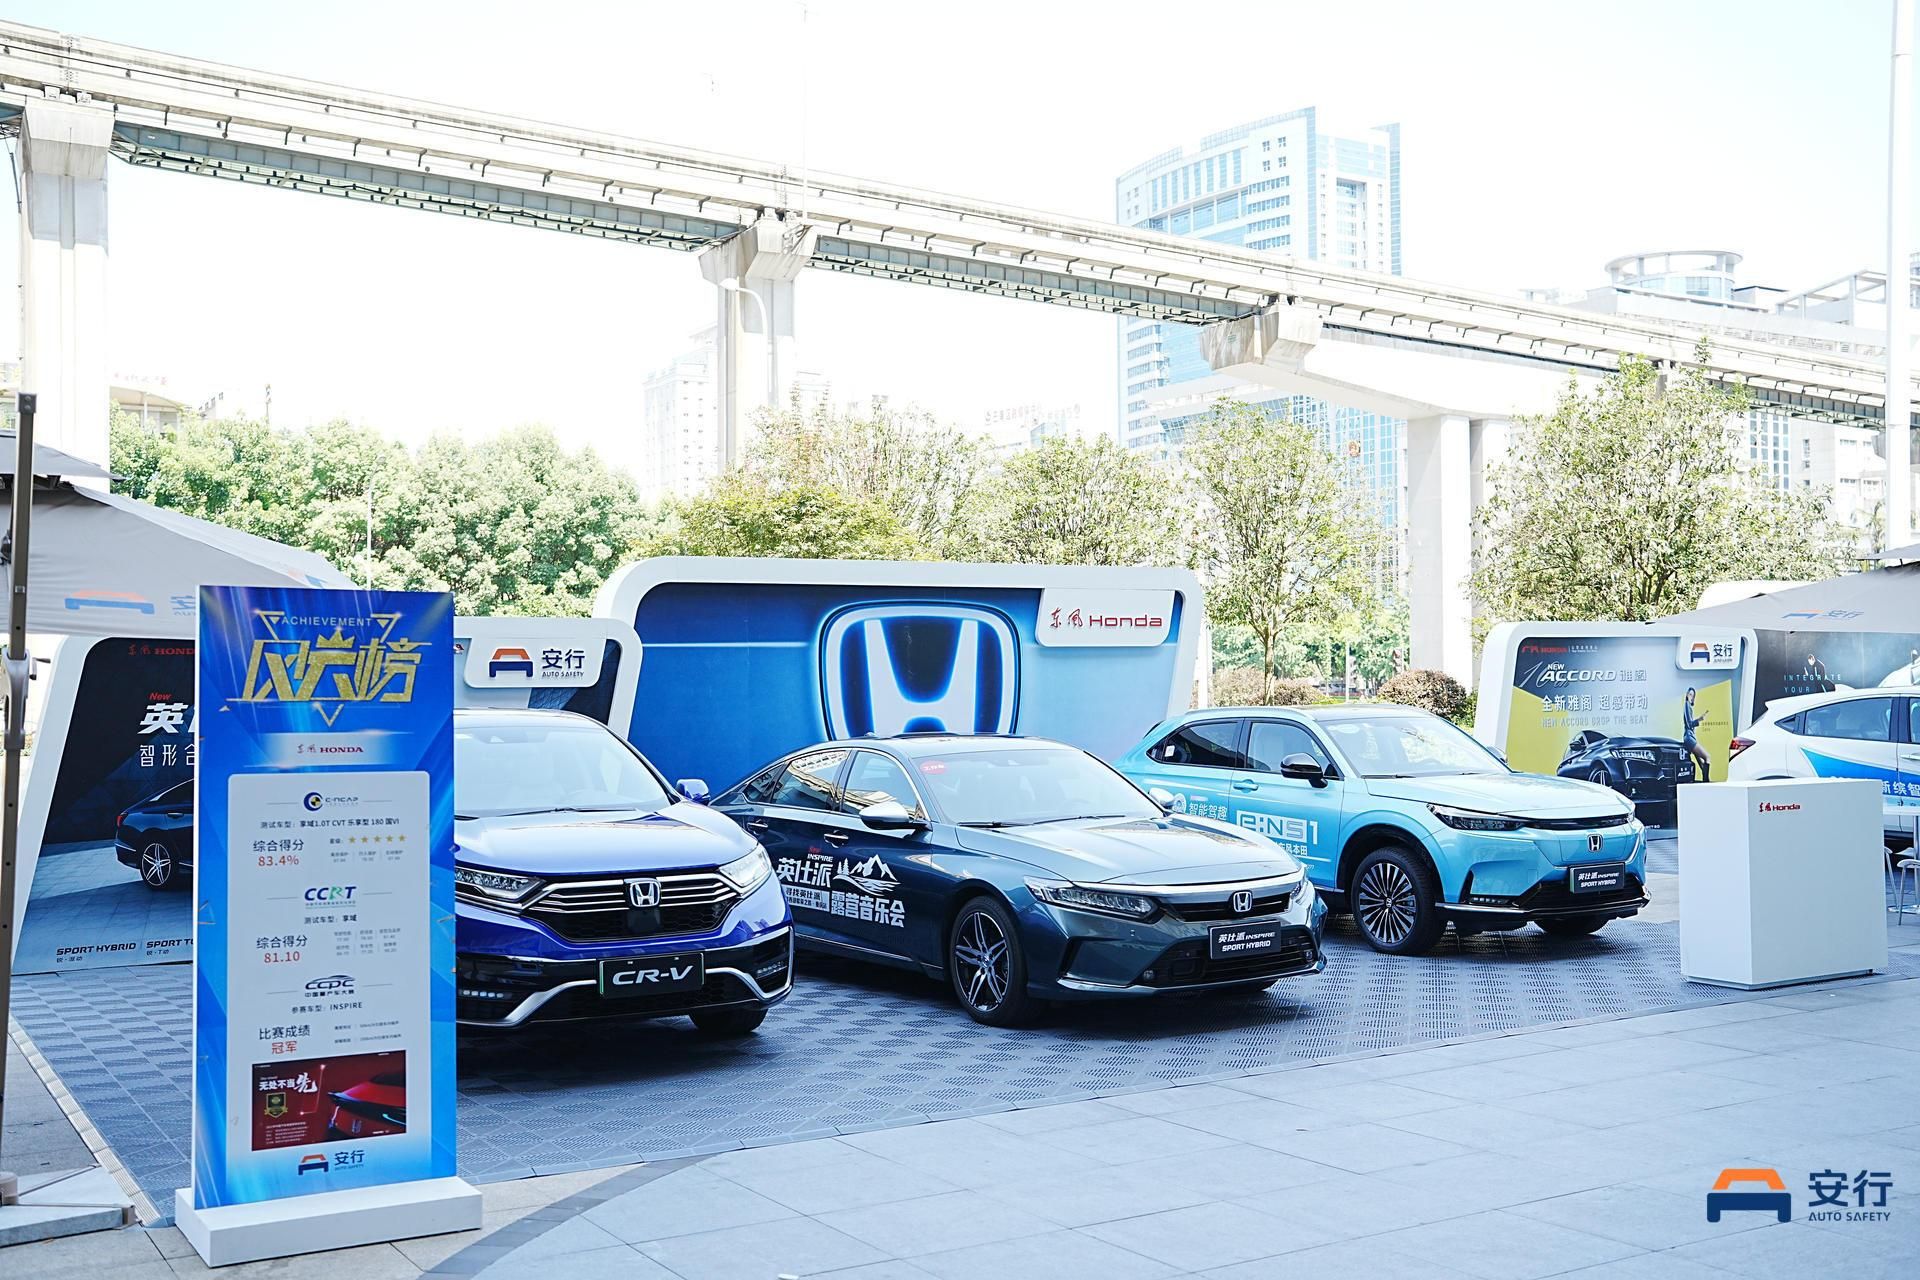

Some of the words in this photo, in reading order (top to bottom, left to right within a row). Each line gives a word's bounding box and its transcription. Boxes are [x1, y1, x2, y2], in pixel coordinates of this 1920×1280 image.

[281, 616, 372, 627] ACHIEVEMENT
[1089, 614, 1162, 627] Honda
[1713, 643, 1733, 657] 安行
[542, 649, 585, 669] 安行
[242, 634, 432, 702] 风云榜
[1540, 670, 1617, 682] ACCORD
[149, 692, 171, 700] New
[1541, 695, 1593, 712] 全新雅阁
[1599, 694, 1648, 710] 超感带动
[1542, 718, 1558, 728] NEW
[1560, 717, 1590, 727] ACCORD
[1614, 715, 1627, 725] THE
[1630, 715, 1648, 725] BEAT
[320, 746, 364, 754] HONDA
[1189, 803, 1228, 821] 智能驾趣
[1772, 803, 1801, 811] Honda
[331, 819, 346, 827] CVT
[371, 818, 384, 826] 180
[253, 839, 305, 853] 综合得分
[258, 855, 300, 867] 83.4%
[807, 853, 833, 862] INSPIRE
[776, 857, 833, 888] 英仕派
[304, 886, 357, 901] CCRT
[831, 890, 906, 928] 露营音乐会
[146, 939, 183, 948] SPORT
[256, 935, 308, 949] 综合得分
[1218, 931, 1246, 943] 英仕派
[1246, 931, 1276, 940] INSPIRE
[56, 945, 95, 956] SPORT
[95, 942, 137, 953] HYBRID
[1221, 943, 1245, 952] SPORT
[1246, 940, 1271, 949] HYBRID
[263, 951, 301, 963] 81.10
[612, 965, 694, 986] CR-V
[329, 1002, 363, 1011] INSPIRE
[259, 1024, 311, 1041] 比赛成绩
[271, 1041, 298, 1054] 冠军
[334, 1150, 365, 1166] 安行
